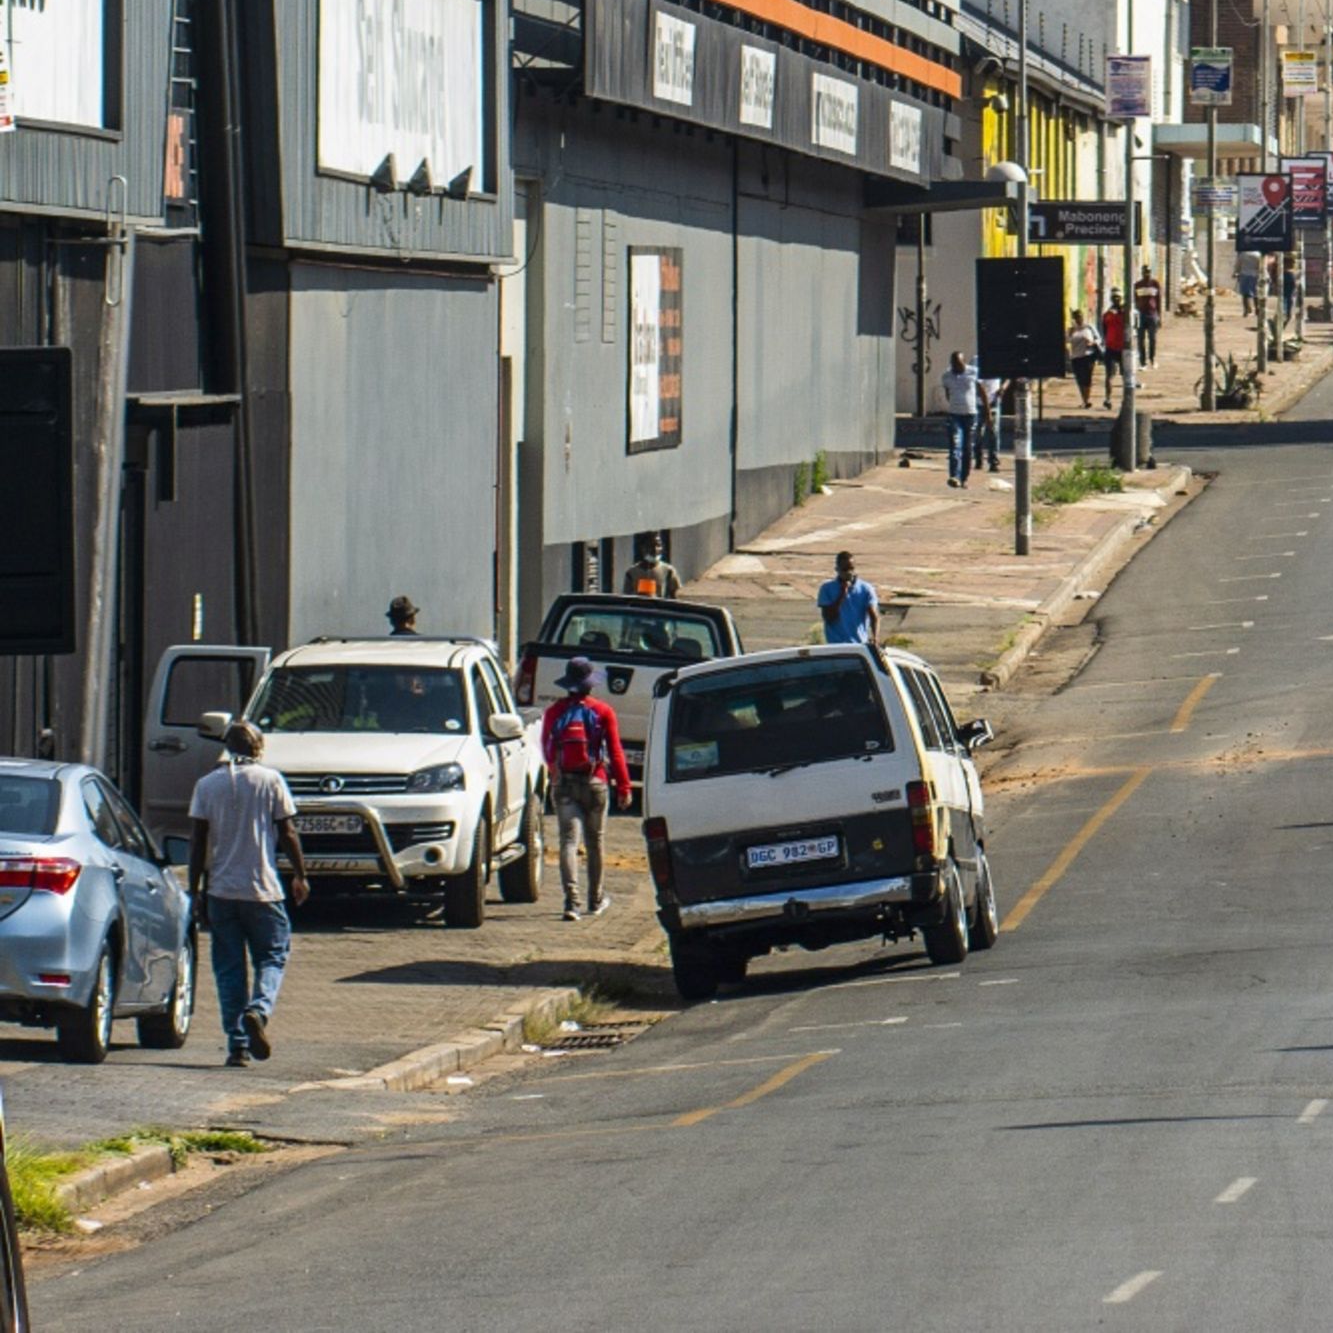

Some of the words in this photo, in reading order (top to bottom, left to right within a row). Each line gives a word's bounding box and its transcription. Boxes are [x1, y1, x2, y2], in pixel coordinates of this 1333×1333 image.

[1058, 210, 1126, 224] Maboneng
[1065, 223, 1120, 235] Precinct
[782, 845, 808, 859] 982
[816, 841, 835, 854] GP
